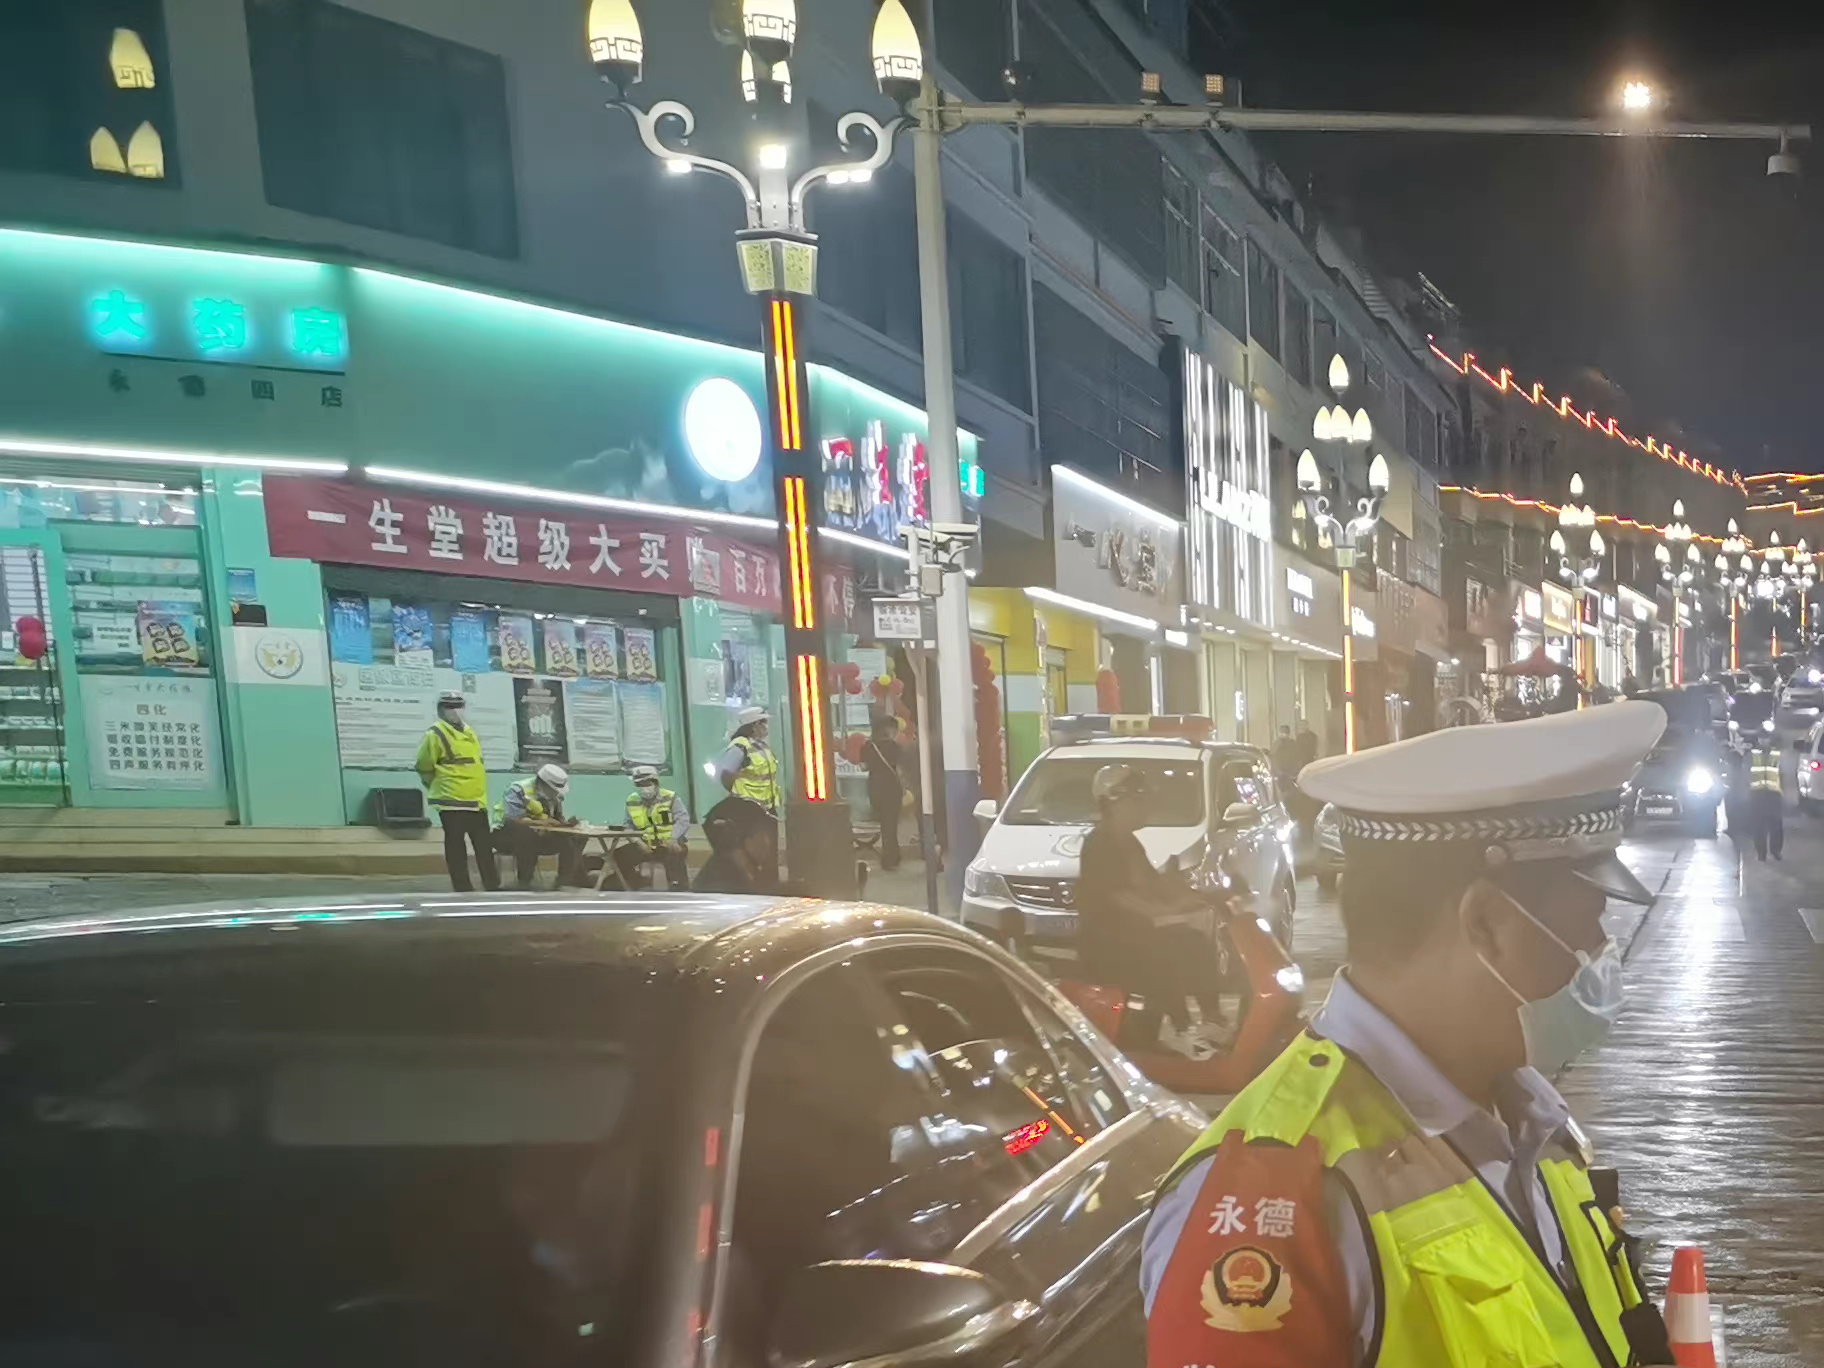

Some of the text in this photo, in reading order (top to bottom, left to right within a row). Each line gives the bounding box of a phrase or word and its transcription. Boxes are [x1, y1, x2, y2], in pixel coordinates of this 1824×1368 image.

[92, 289, 342, 355] 大药房
[1207, 1194, 1296, 1239] 永德
